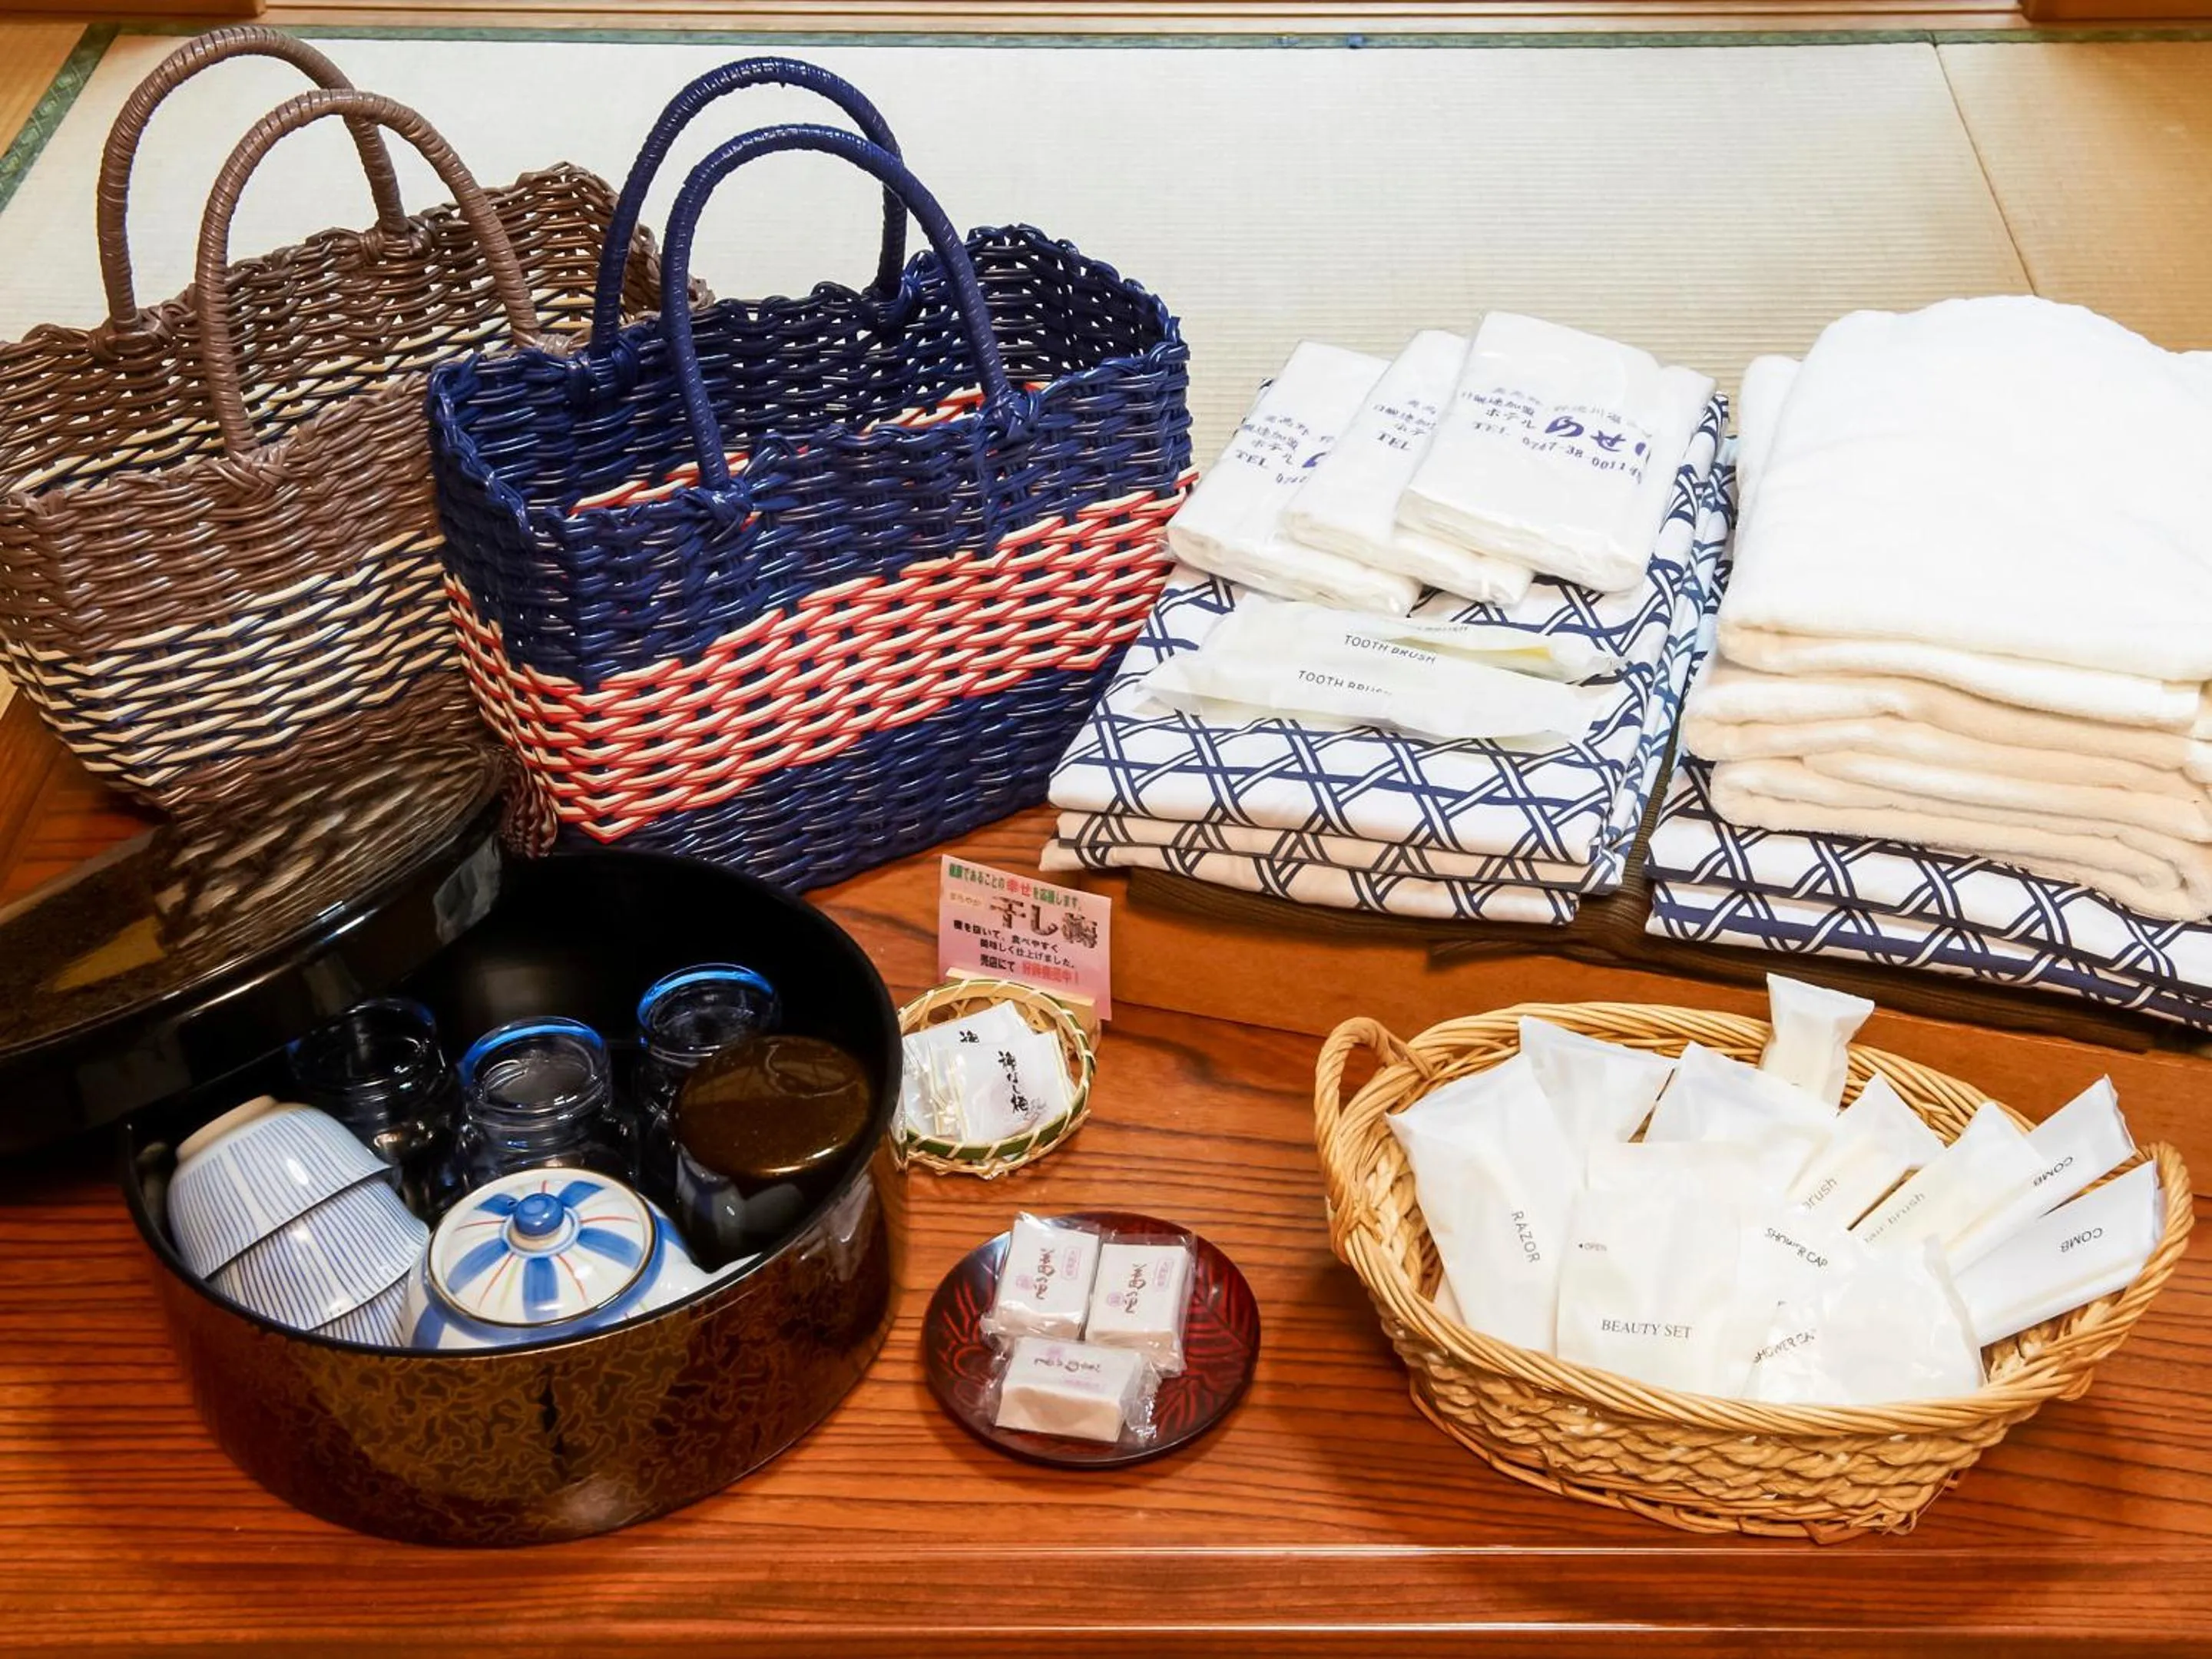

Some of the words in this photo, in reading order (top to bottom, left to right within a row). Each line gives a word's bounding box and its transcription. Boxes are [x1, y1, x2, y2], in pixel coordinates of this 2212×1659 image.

[1376, 430, 1412, 451] TEL
[1236, 449, 1268, 469] TEL
[1345, 634, 1389, 652] TOOTH
[1391, 646, 1436, 664] BRUSH
[1299, 670, 1344, 687] TOOTH
[988, 896, 1098, 949] 干し梅
[2034, 1156, 2073, 1187] COMB
[1511, 1210, 1541, 1263] RAZOR
[2060, 1227, 2103, 1253] COMB
[1584, 1242, 1608, 1253] OPEN
[1806, 1250, 1828, 1267] CAP
[1601, 1319, 1661, 1336] BEAUTY
[1664, 1323, 1693, 1340] SET
